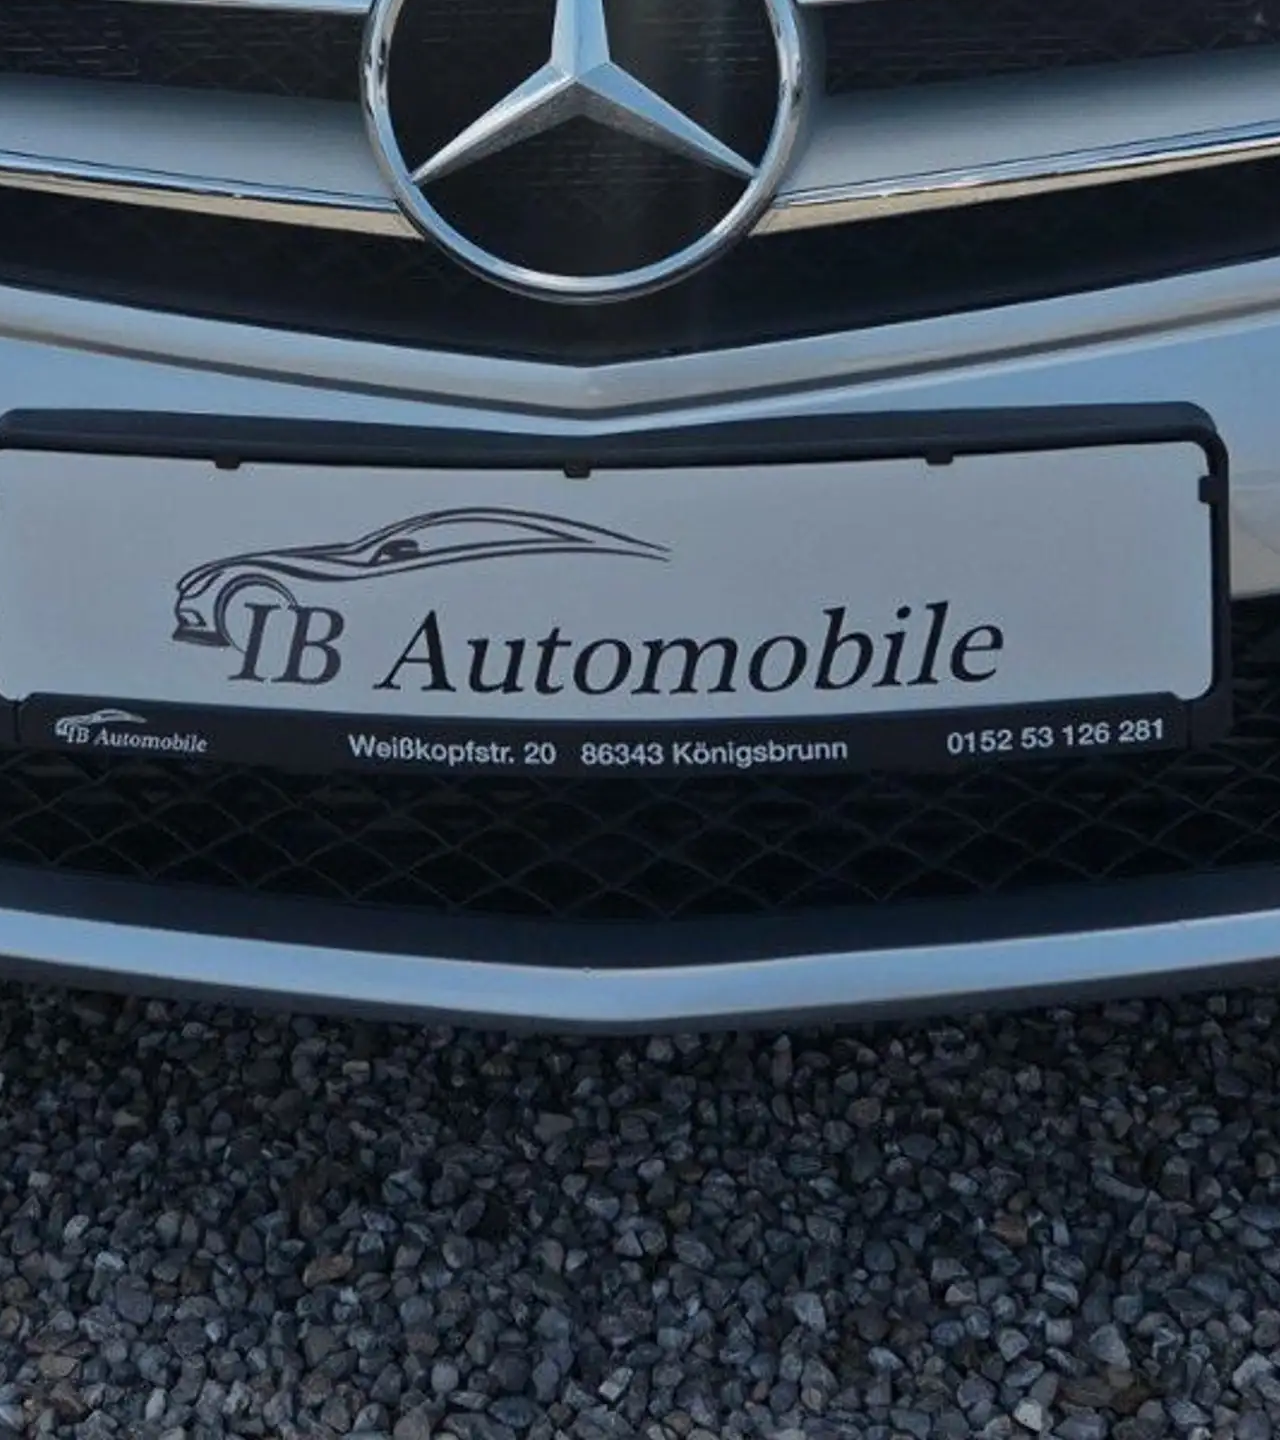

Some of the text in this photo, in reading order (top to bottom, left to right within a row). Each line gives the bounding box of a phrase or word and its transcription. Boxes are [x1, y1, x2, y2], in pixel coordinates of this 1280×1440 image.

[373, 600, 1005, 697] Automobile
[93, 728, 209, 753] Automobile
[347, 733, 849, 768] Weißkopfstr. 20 86343 Königsbrunn
[946, 717, 1164, 755] 0152 53 126 281
